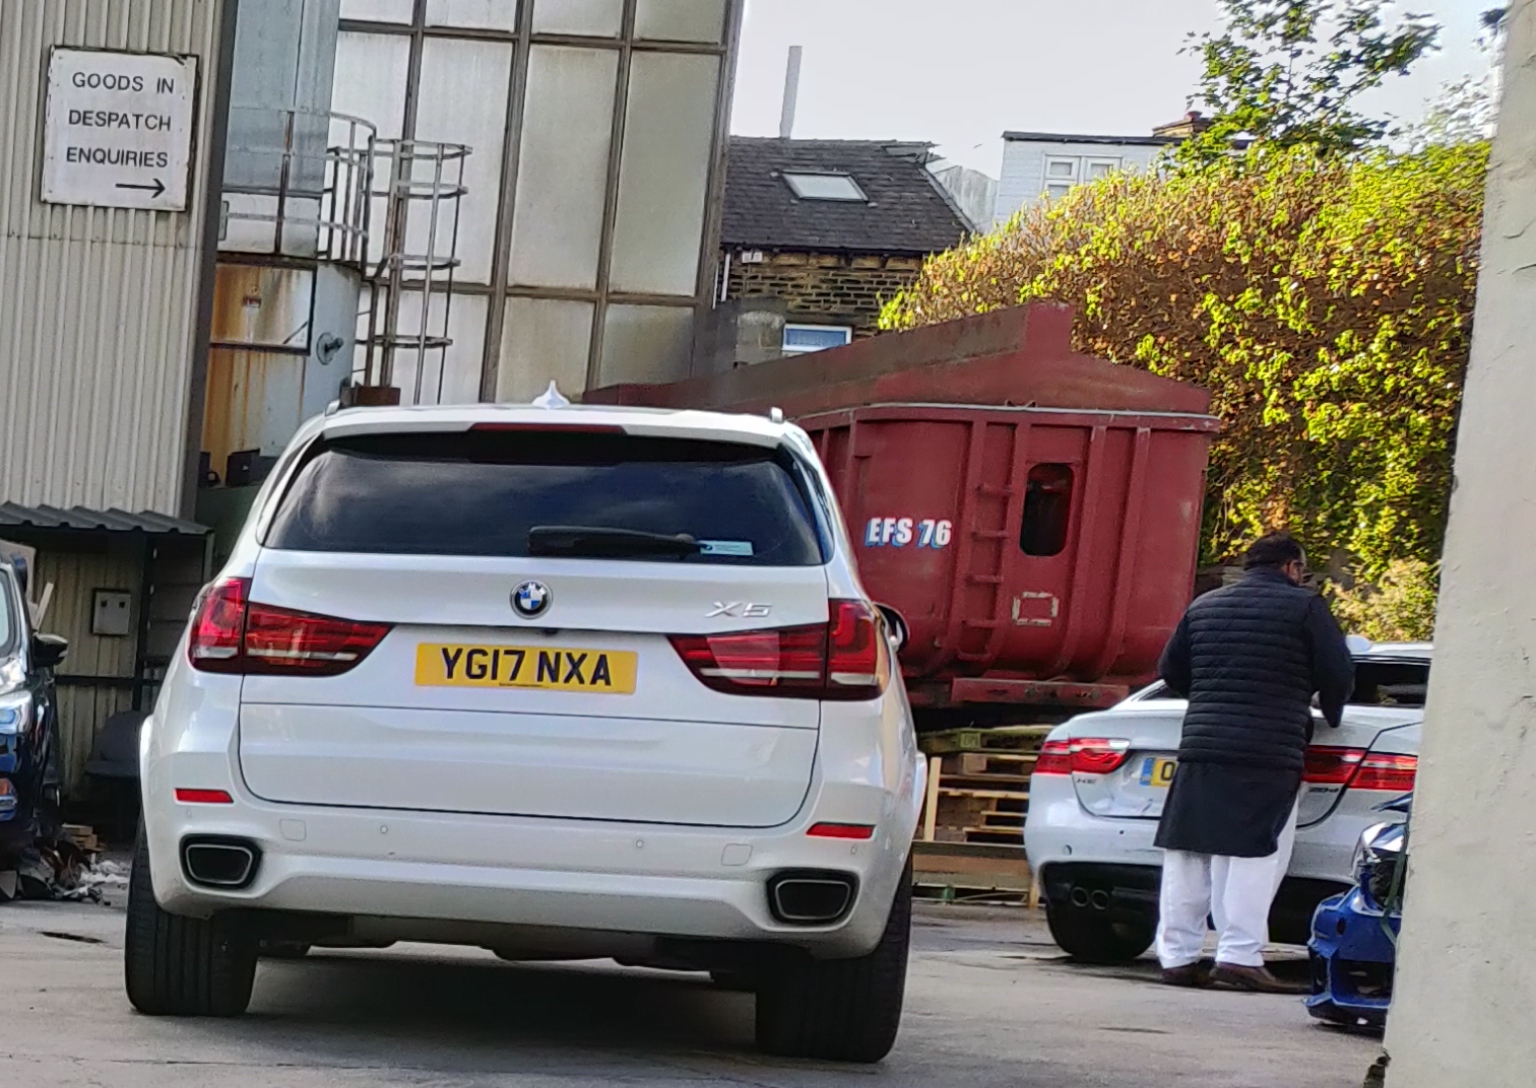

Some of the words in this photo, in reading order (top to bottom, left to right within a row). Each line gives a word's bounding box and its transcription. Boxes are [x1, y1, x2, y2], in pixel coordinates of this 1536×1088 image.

[72, 72, 144, 92] GOODS
[156, 77, 174, 94] IN
[69, 109, 171, 131] DESPATCH
[66, 146, 168, 168] ENQUIRIES
[865, 517, 913, 546] EFS
[917, 519, 952, 548] 76
[704, 601, 772, 618] X5
[442, 647, 526, 681] YG17
[537, 650, 612, 686] NXA
